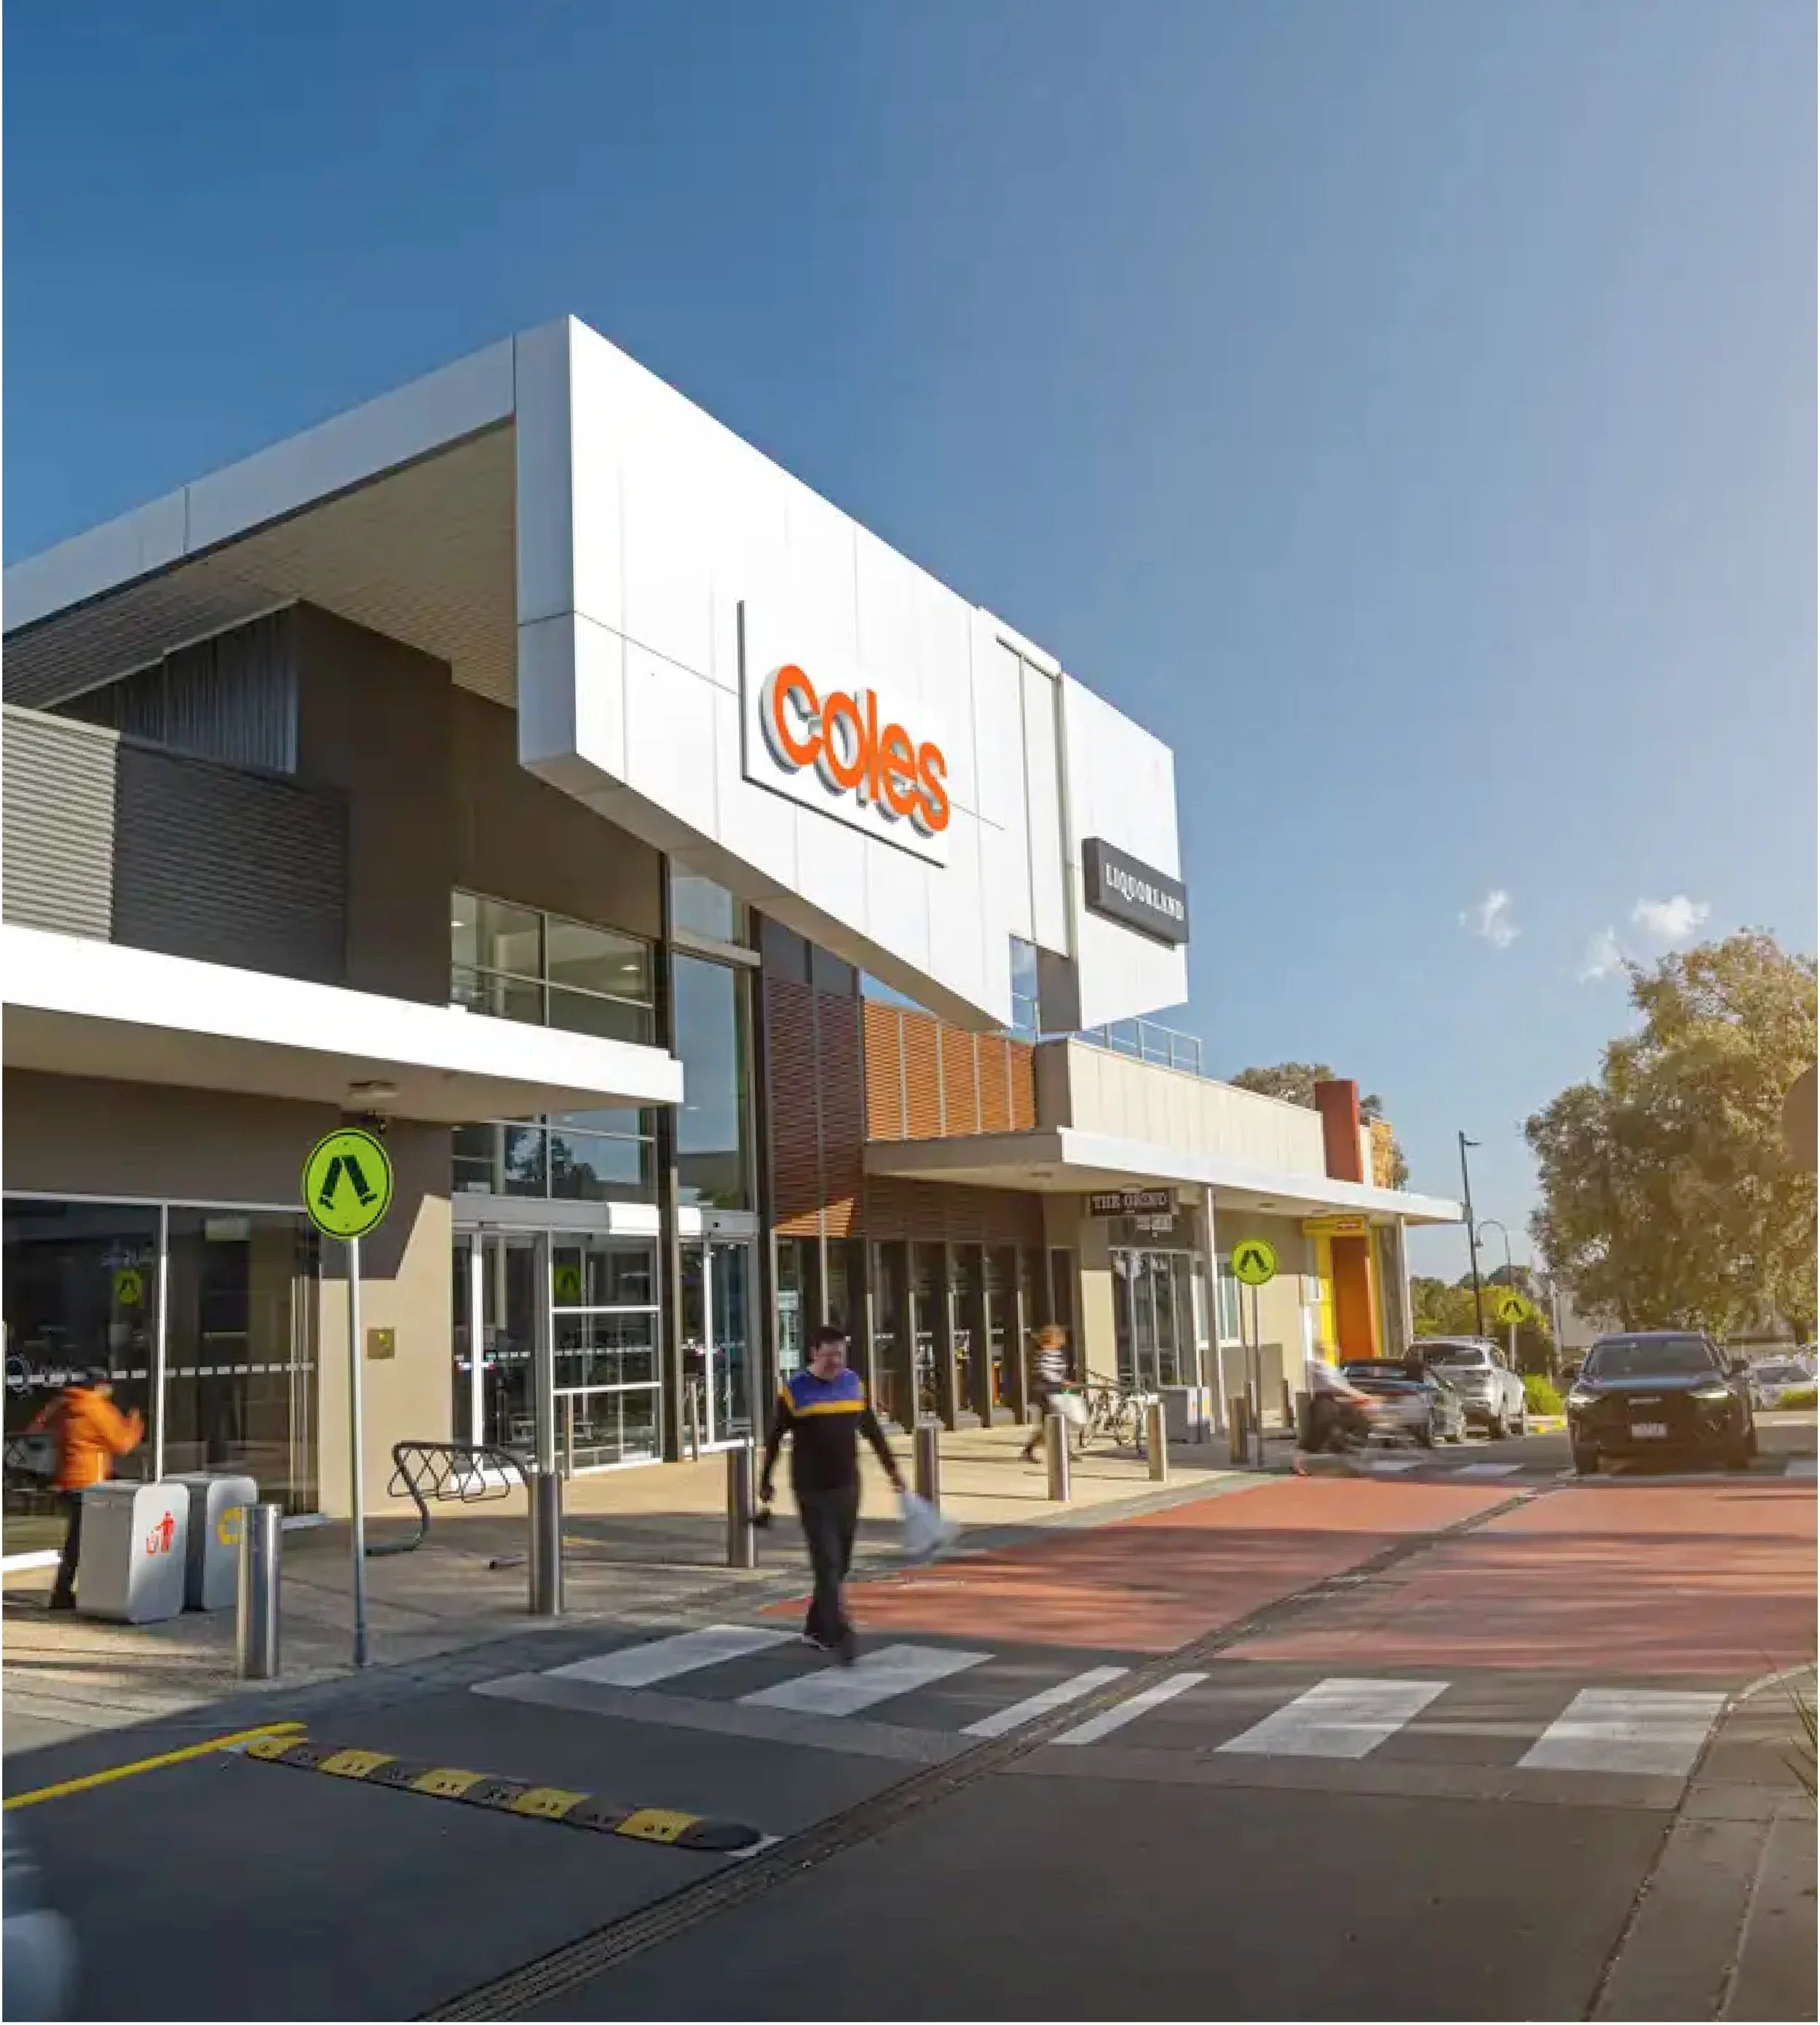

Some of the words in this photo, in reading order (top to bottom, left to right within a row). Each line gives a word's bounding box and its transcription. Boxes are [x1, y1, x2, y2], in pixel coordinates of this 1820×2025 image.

[769, 663, 950, 832] coles
[1106, 862, 1184, 921] LIQUORLAND
[1092, 1194, 1120, 1209] THE
